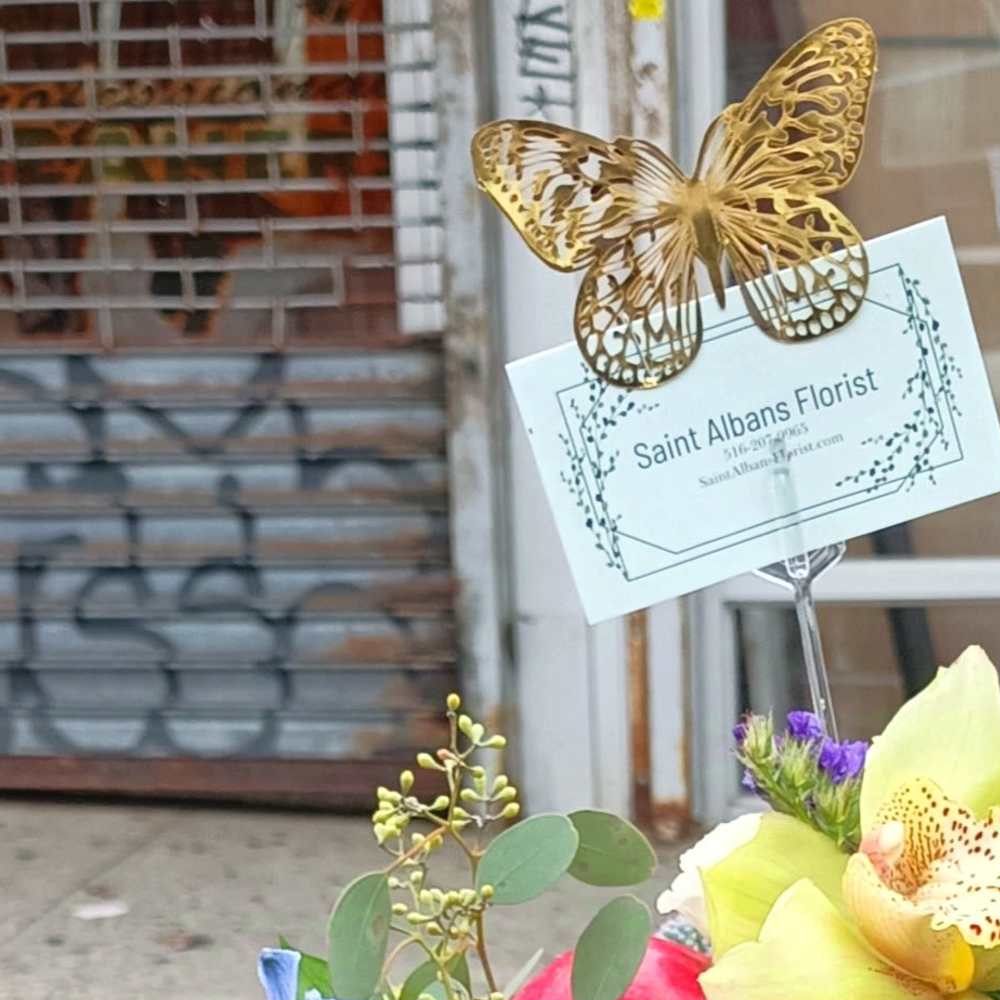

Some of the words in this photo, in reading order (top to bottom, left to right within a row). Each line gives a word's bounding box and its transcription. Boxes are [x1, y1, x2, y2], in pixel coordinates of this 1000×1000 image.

[633, 427, 701, 470] Saint
[707, 401, 791, 446] Albans
[794, 368, 879, 415] Florist
